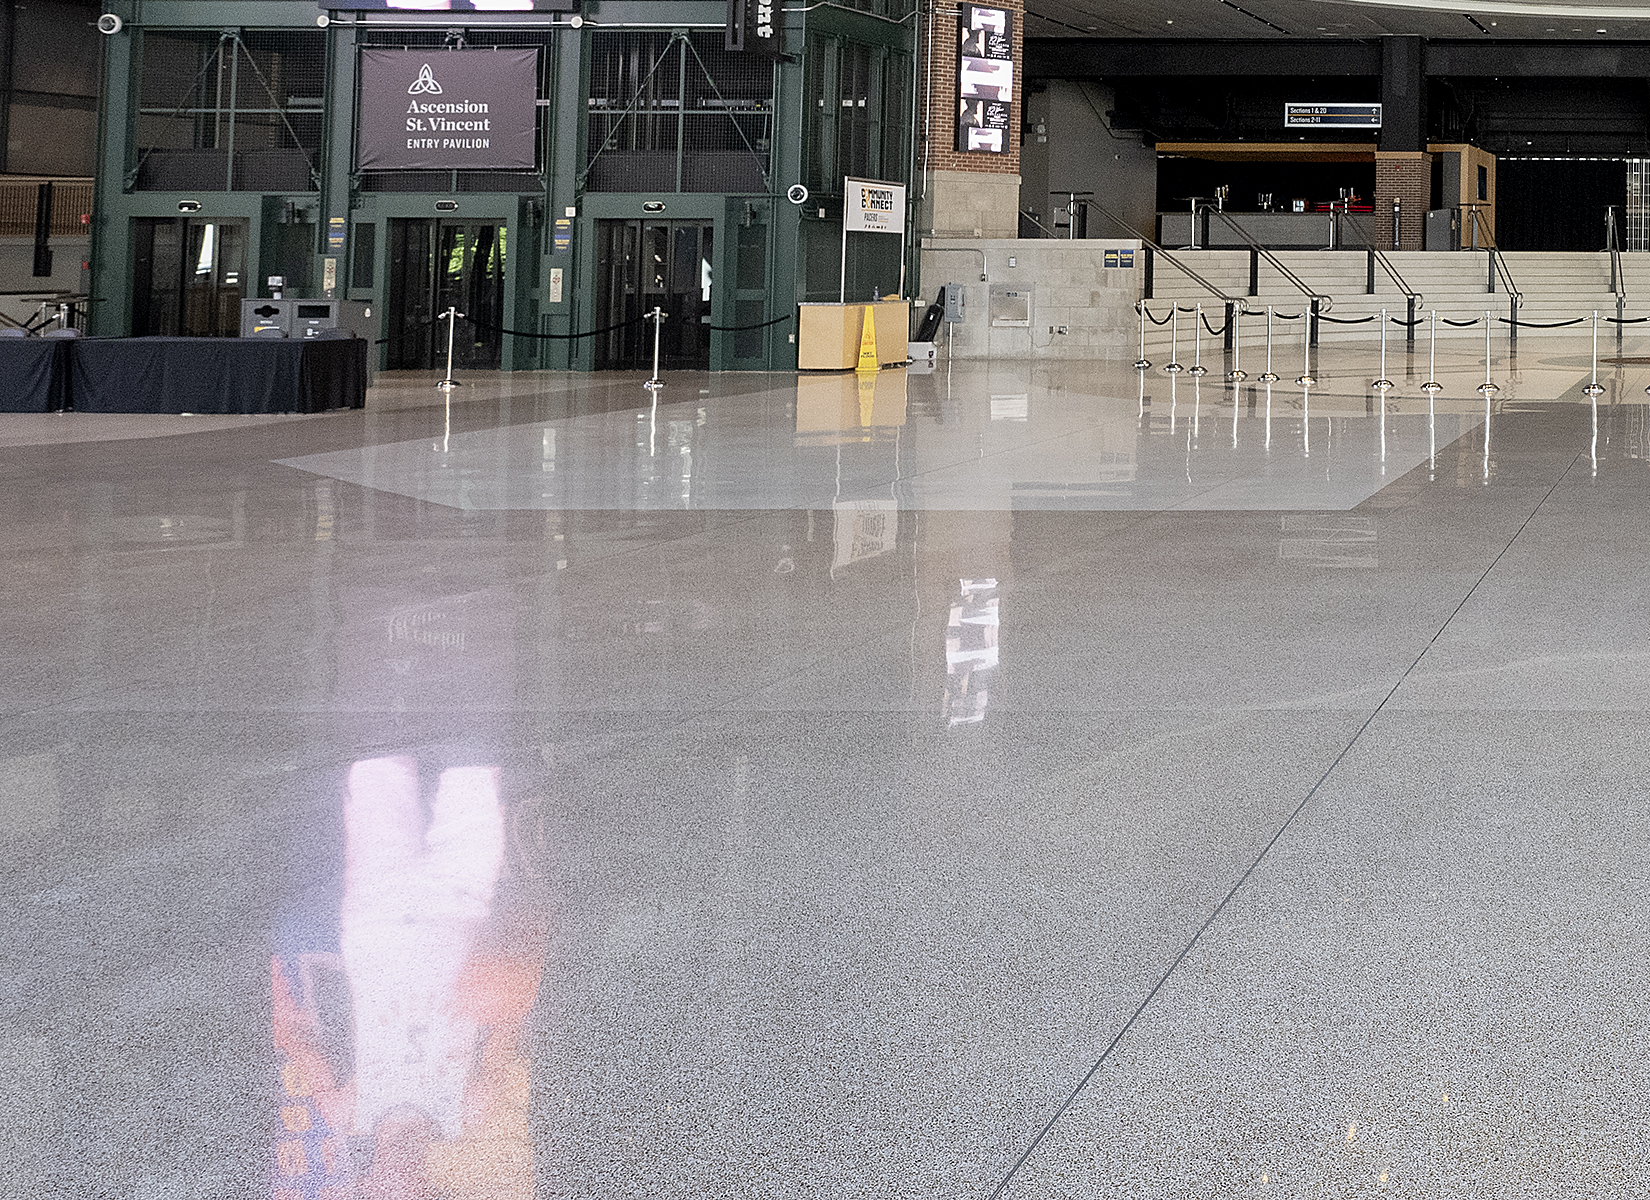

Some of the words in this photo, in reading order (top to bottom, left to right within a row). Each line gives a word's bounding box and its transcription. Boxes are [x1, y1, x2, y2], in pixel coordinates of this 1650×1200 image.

[407, 99, 489, 114] Ascension
[406, 117, 427, 132] St.
[428, 117, 490, 132] Vincent
[407, 138, 440, 149] ENTRY
[443, 138, 490, 149] PAVILION
[861, 198, 893, 210] CONNECT
